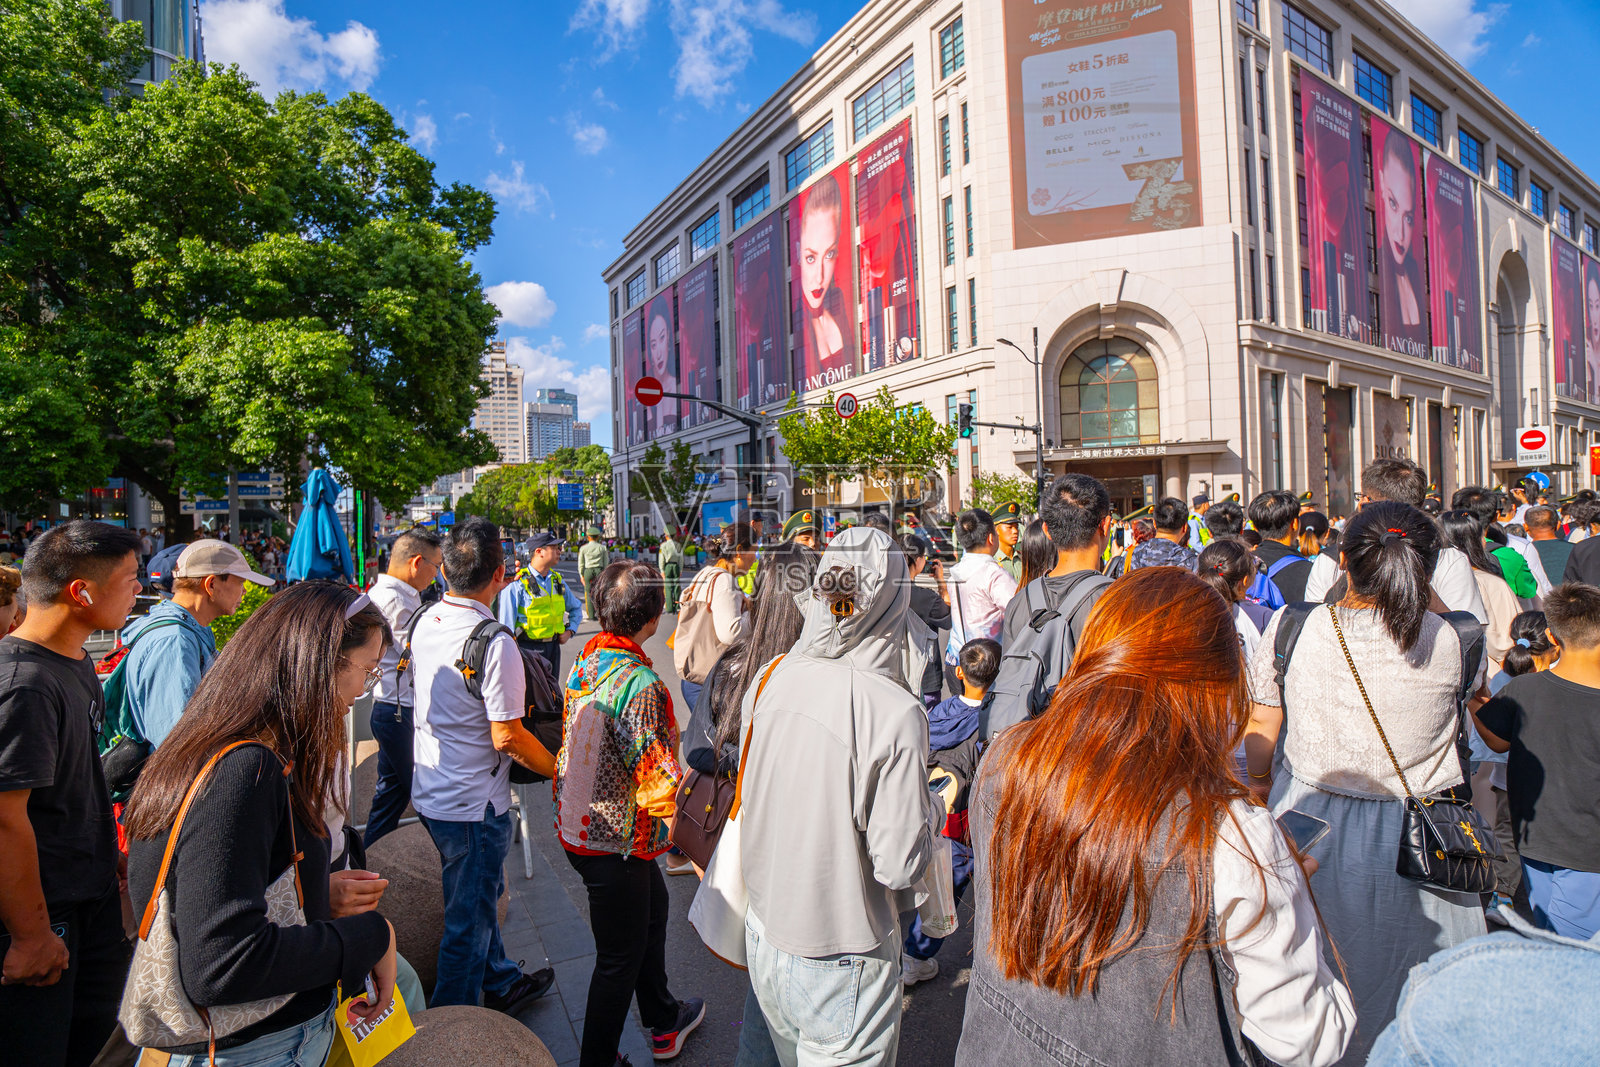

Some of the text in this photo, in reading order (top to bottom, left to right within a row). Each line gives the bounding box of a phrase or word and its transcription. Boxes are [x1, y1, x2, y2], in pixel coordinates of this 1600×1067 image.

[1029, 28, 1060, 42] Modern
[1040, 34, 1061, 48] Style
[1067, 53, 1129, 74] 女鞋5折起
[1042, 87, 1106, 108] 满800元
[1042, 105, 1107, 127] 赠100元
[1046, 146, 1074, 155] BELLE
[1384, 333, 1428, 360] LANCÔME
[841, 399, 854, 413] 40
[1071, 446, 1167, 459] 上海新世界大丸百货
